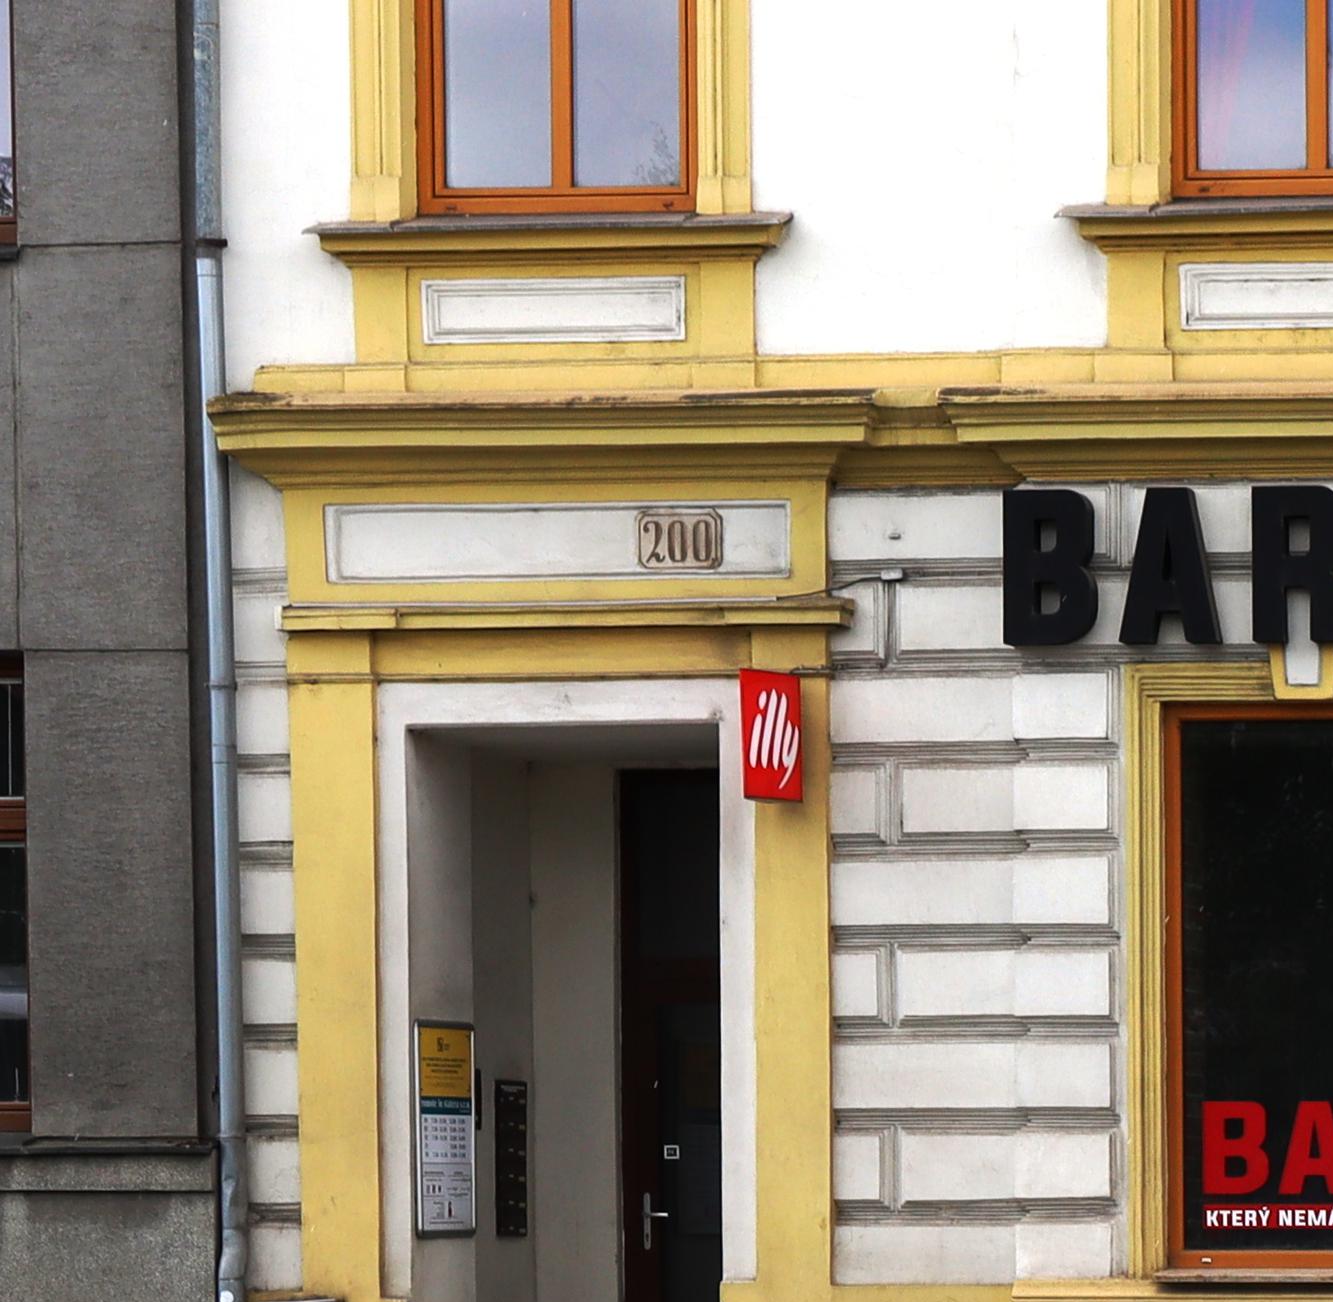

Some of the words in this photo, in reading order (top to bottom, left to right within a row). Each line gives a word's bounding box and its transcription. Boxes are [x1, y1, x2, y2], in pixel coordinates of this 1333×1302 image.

[643, 520, 714, 563] 200
[749, 688, 799, 789] illy
[1206, 1206, 1270, 1227] KTERÝ
